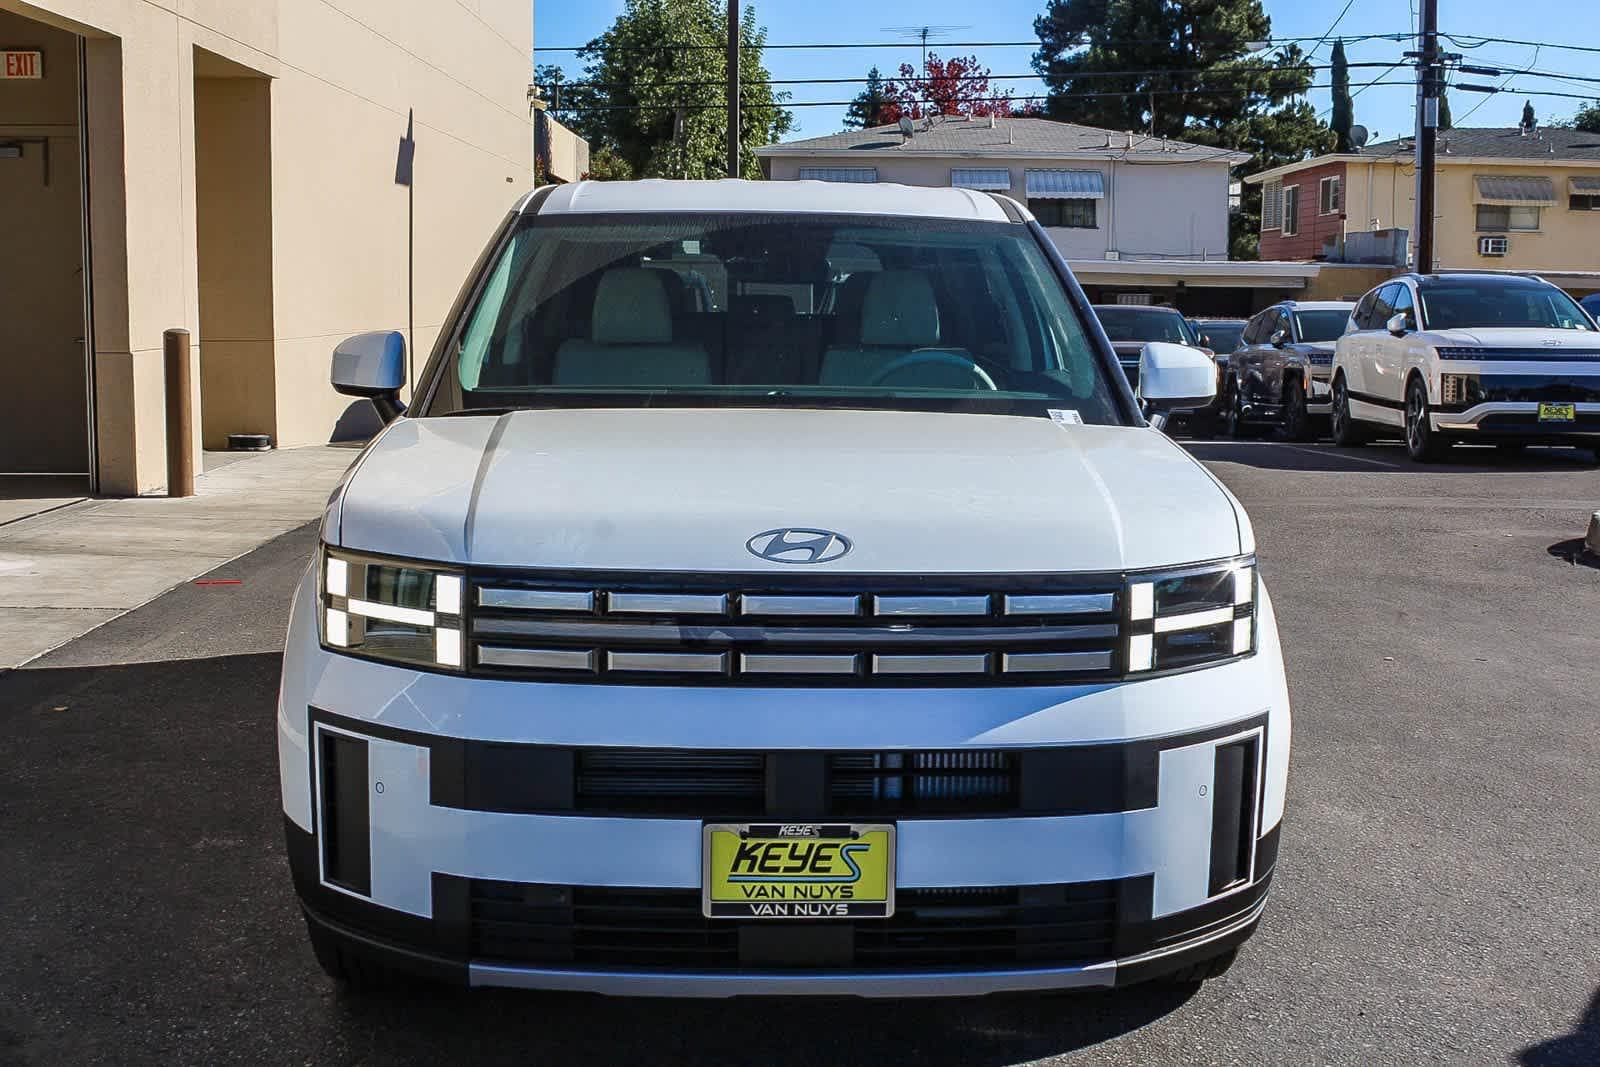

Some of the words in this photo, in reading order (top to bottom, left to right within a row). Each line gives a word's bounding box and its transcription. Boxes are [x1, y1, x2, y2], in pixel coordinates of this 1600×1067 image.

[7, 53, 35, 76] EXIT
[778, 825, 821, 836] KEYES
[729, 842, 871, 881] KEYES
[741, 885, 785, 898] VAN
[793, 885, 853, 899] NUYS
[750, 903, 786, 916] VAN
[794, 903, 849, 916] NUYS
